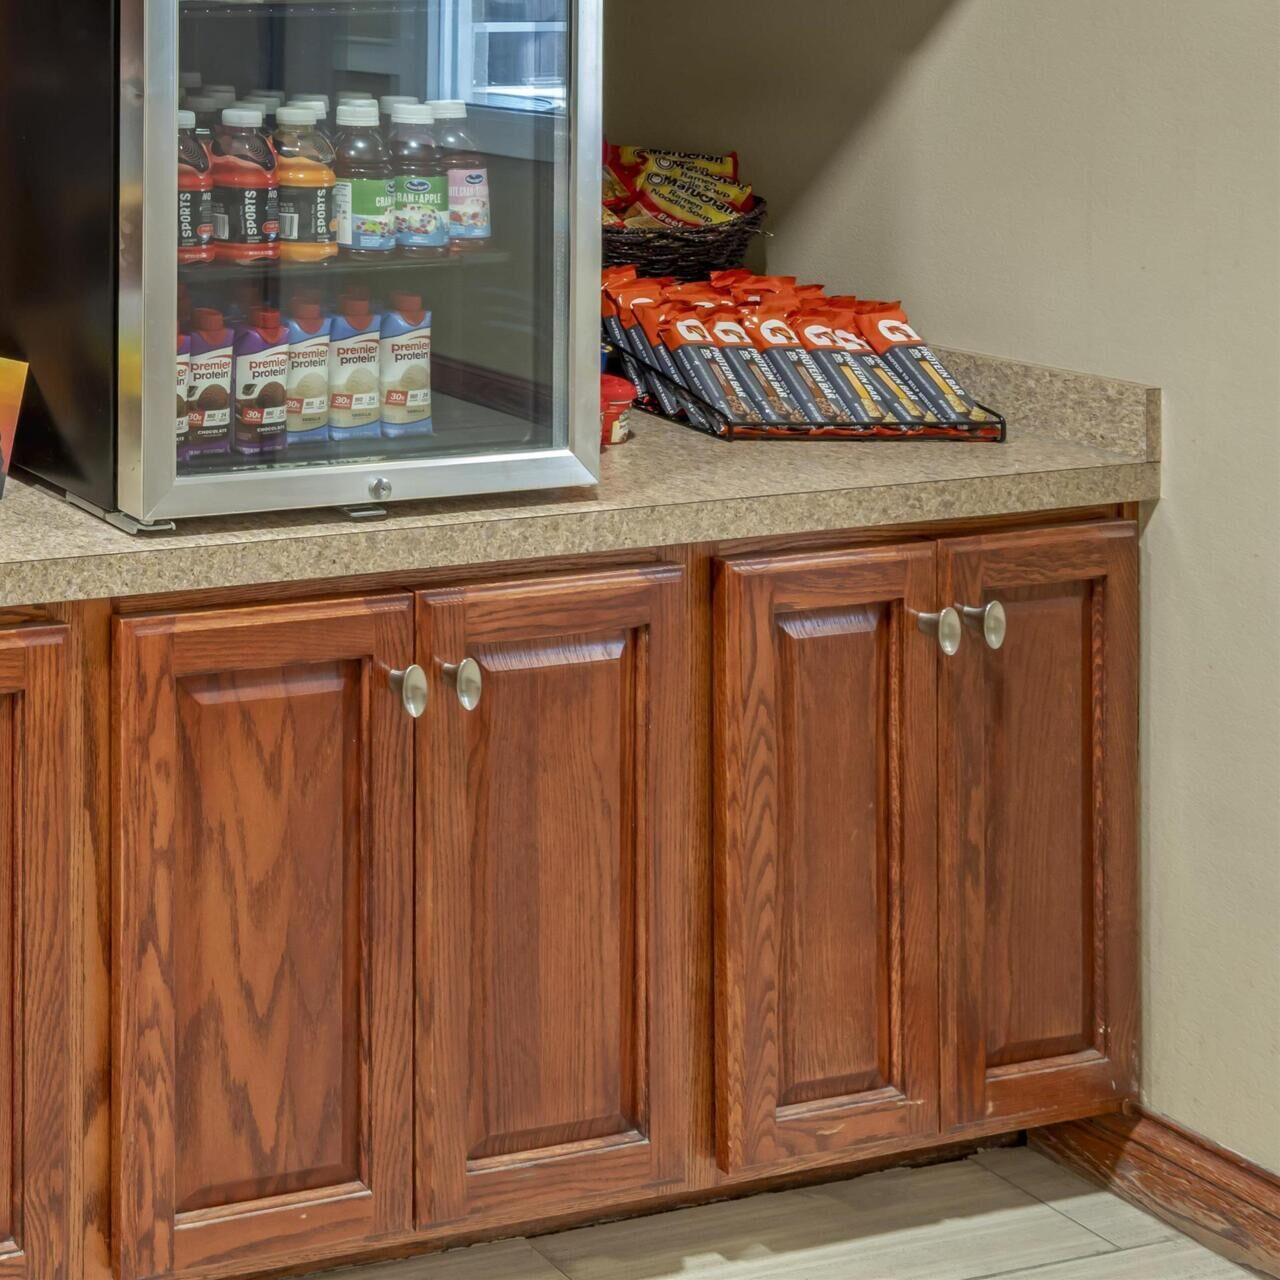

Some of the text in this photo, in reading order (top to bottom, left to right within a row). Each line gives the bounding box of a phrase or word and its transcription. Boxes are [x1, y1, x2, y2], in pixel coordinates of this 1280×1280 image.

[202, 192, 211, 200] NO
[268, 190, 277, 198] NO
[419, 193, 441, 203] APPLE
[664, 176, 735, 215] Maruchan
[704, 183, 731, 199] Soup
[651, 188, 713, 224] Noodle Soup
[669, 190, 703, 211] Ramen
[180, 192, 192, 237] SPORTS
[245, 190, 257, 235] SPORTS
[317, 189, 326, 233] SPORTS
[658, 213, 683, 228] Beef
[289, 349, 328, 360] premier
[336, 345, 378, 357] premier
[391, 341, 431, 353] premier
[340, 355, 376, 366] protein
[394, 351, 428, 362] protein
[191, 361, 230, 372] premier
[291, 360, 326, 369] protein
[709, 347, 746, 397] PROTEIN BAR
[917, 346, 965, 395] PROTEIN BAR
[194, 371, 228, 381] protein
[252, 369, 286, 379] protein
[747, 348, 788, 398] PROTEIN BAR
[795, 349, 836, 399] PROTEIN BAR
[841, 351, 881, 400] PROTEIN BAR
[899, 385, 919, 400] BAR
